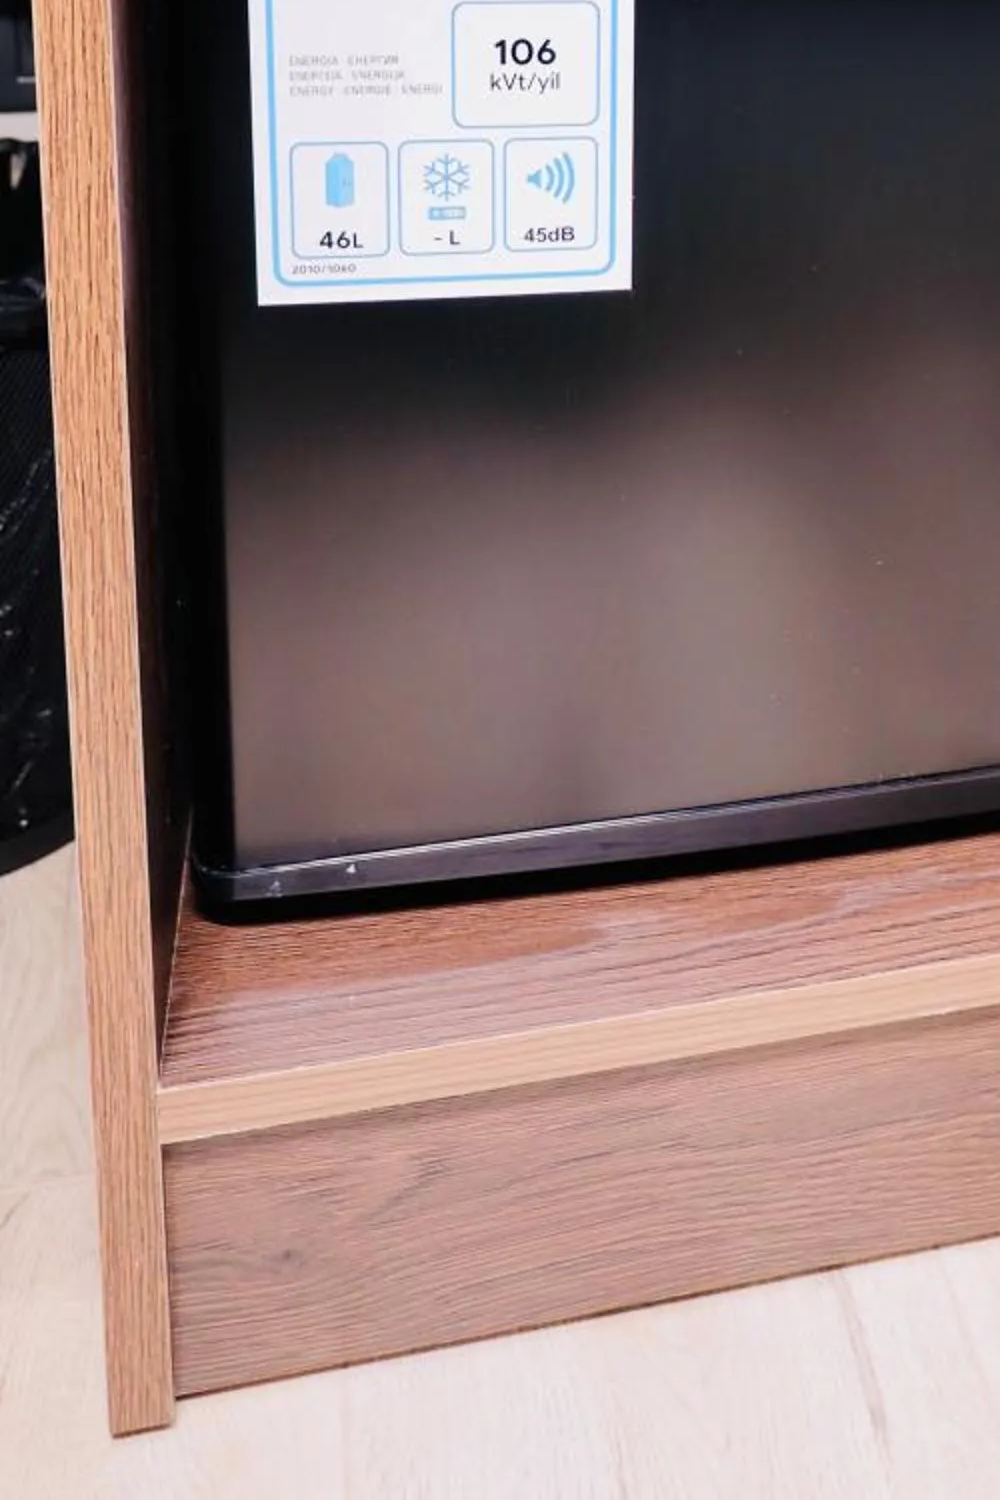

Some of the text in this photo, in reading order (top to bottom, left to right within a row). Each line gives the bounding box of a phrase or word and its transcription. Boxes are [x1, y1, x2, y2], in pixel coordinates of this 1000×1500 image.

[493, 38, 557, 66] 106
[319, 231, 364, 250] 46L
[523, 227, 576, 243] 45dB
